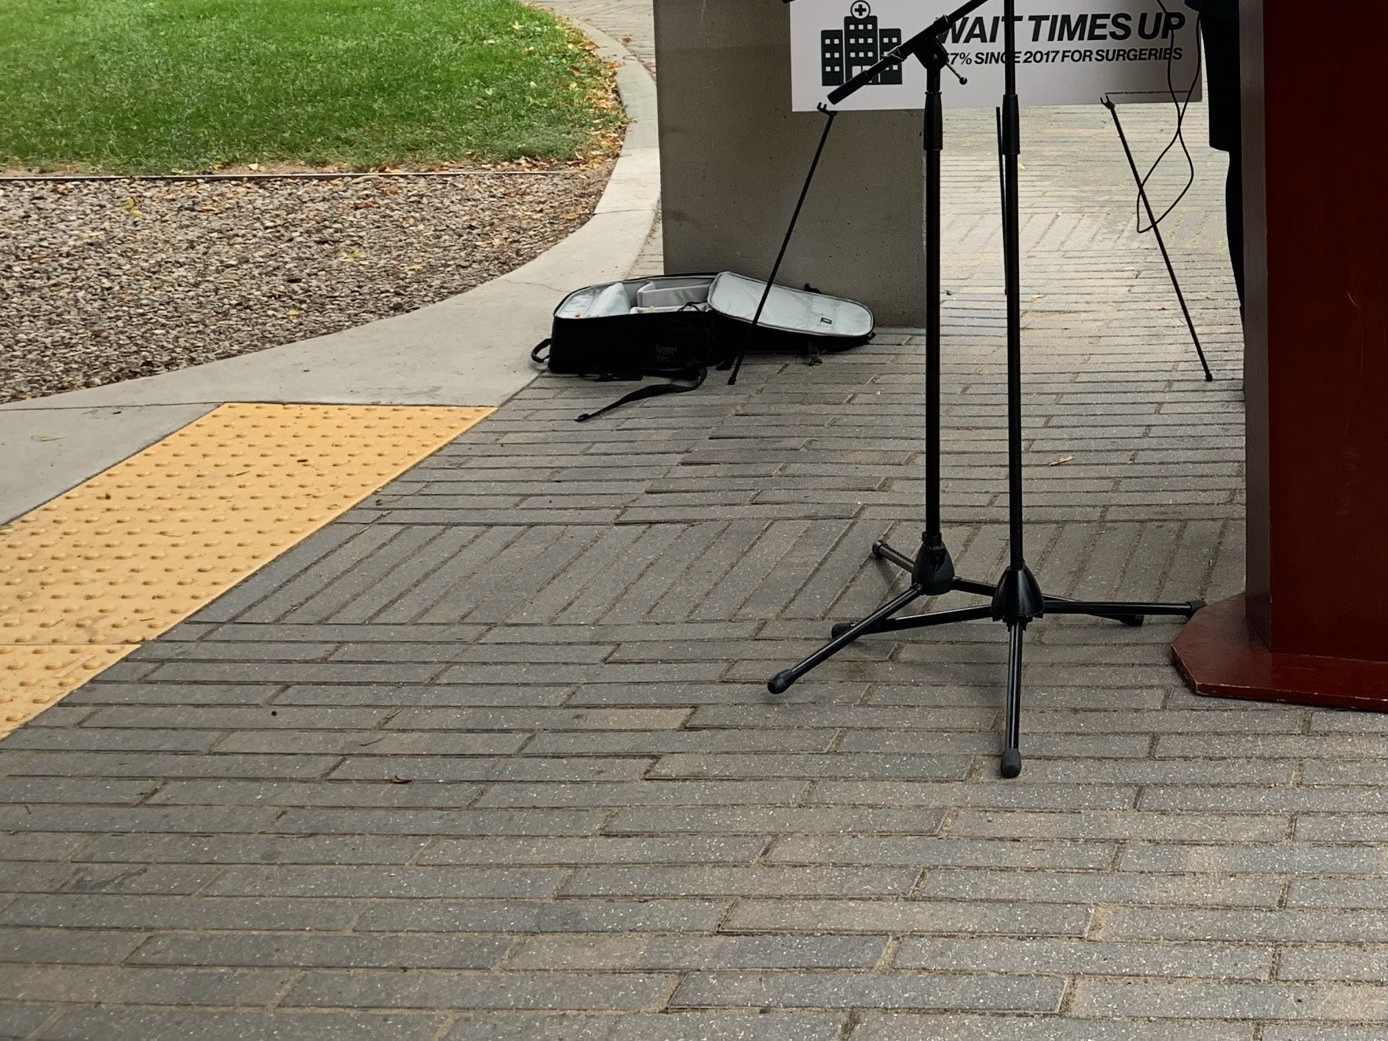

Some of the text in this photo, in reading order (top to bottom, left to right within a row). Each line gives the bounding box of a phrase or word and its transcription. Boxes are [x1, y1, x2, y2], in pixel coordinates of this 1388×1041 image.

[1028, 13, 1132, 41] TIMES
[1138, 12, 1186, 41] UP
[1023, 50, 1060, 63] 2017
[1061, 50, 1093, 62] FOR
[1096, 48, 1183, 62] SURGERIES
